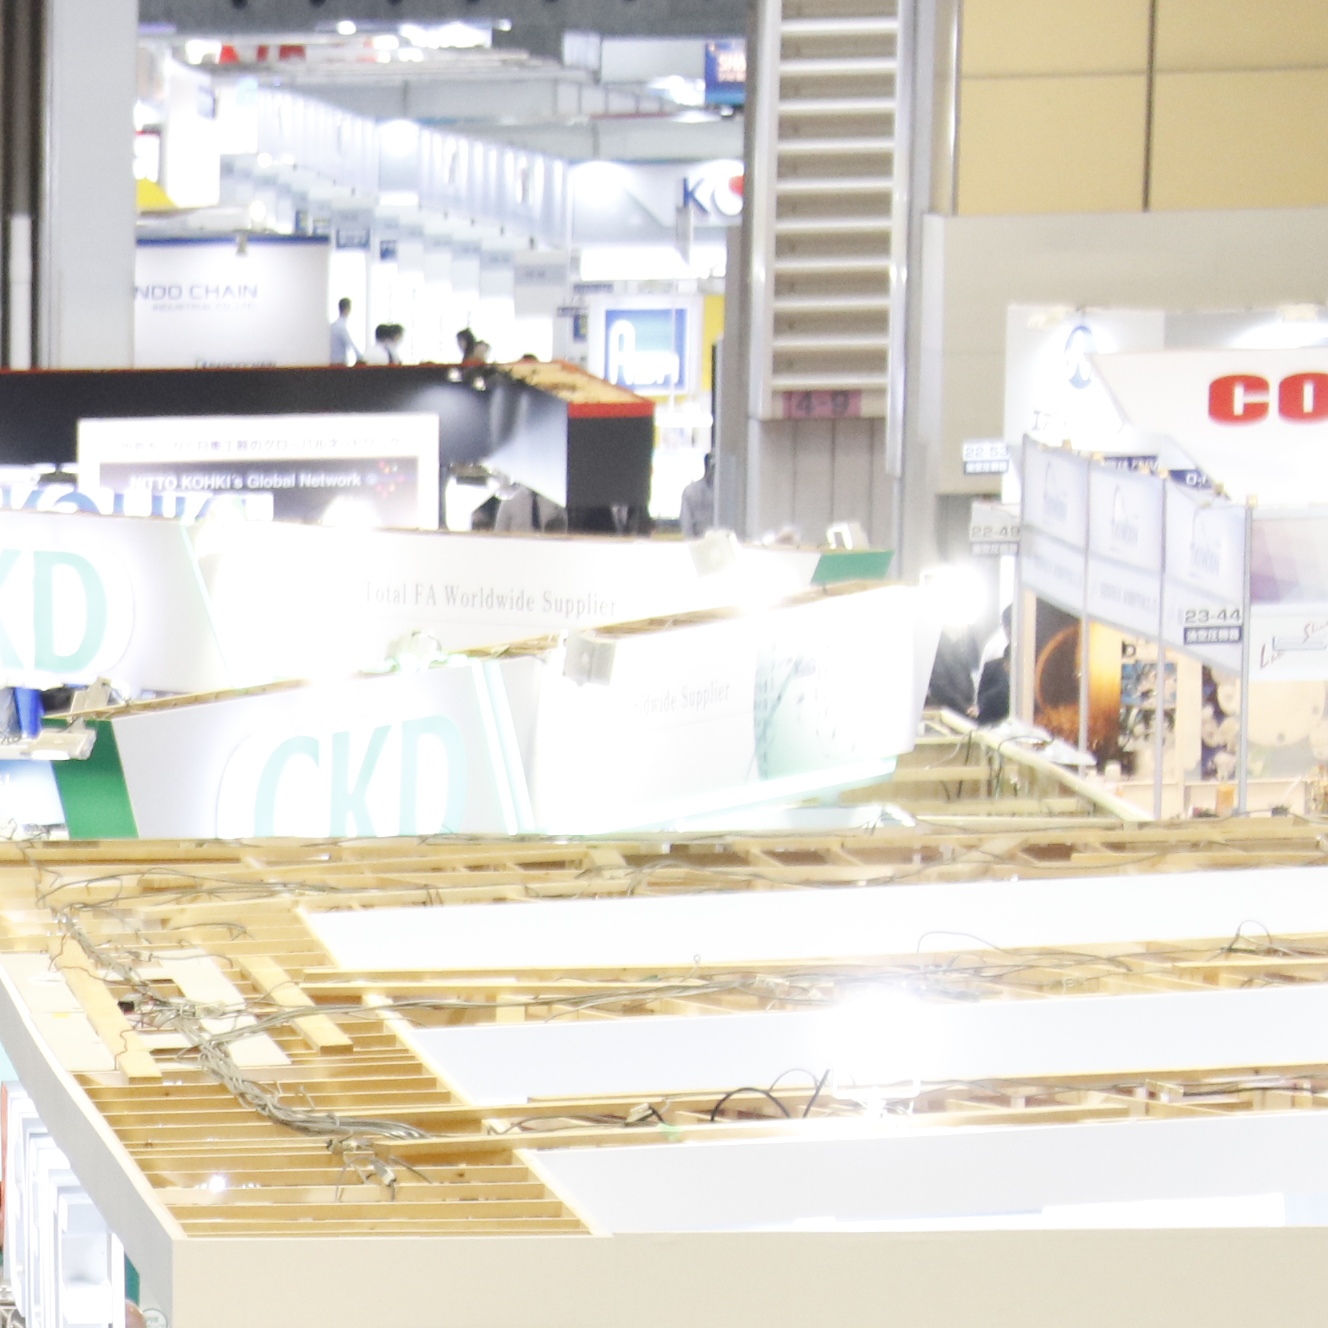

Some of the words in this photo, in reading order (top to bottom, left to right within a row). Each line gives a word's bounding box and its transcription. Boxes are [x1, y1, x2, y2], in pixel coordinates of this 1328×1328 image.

[135, 284, 182, 300] NDO
[189, 284, 259, 299] CHAIN
[248, 473, 296, 489] Global
[300, 472, 362, 488] Network
[414, 583, 438, 607] FA
[445, 585, 535, 613] Worldwide
[543, 590, 616, 619] Supplier
[255, 712, 468, 838] CKD
